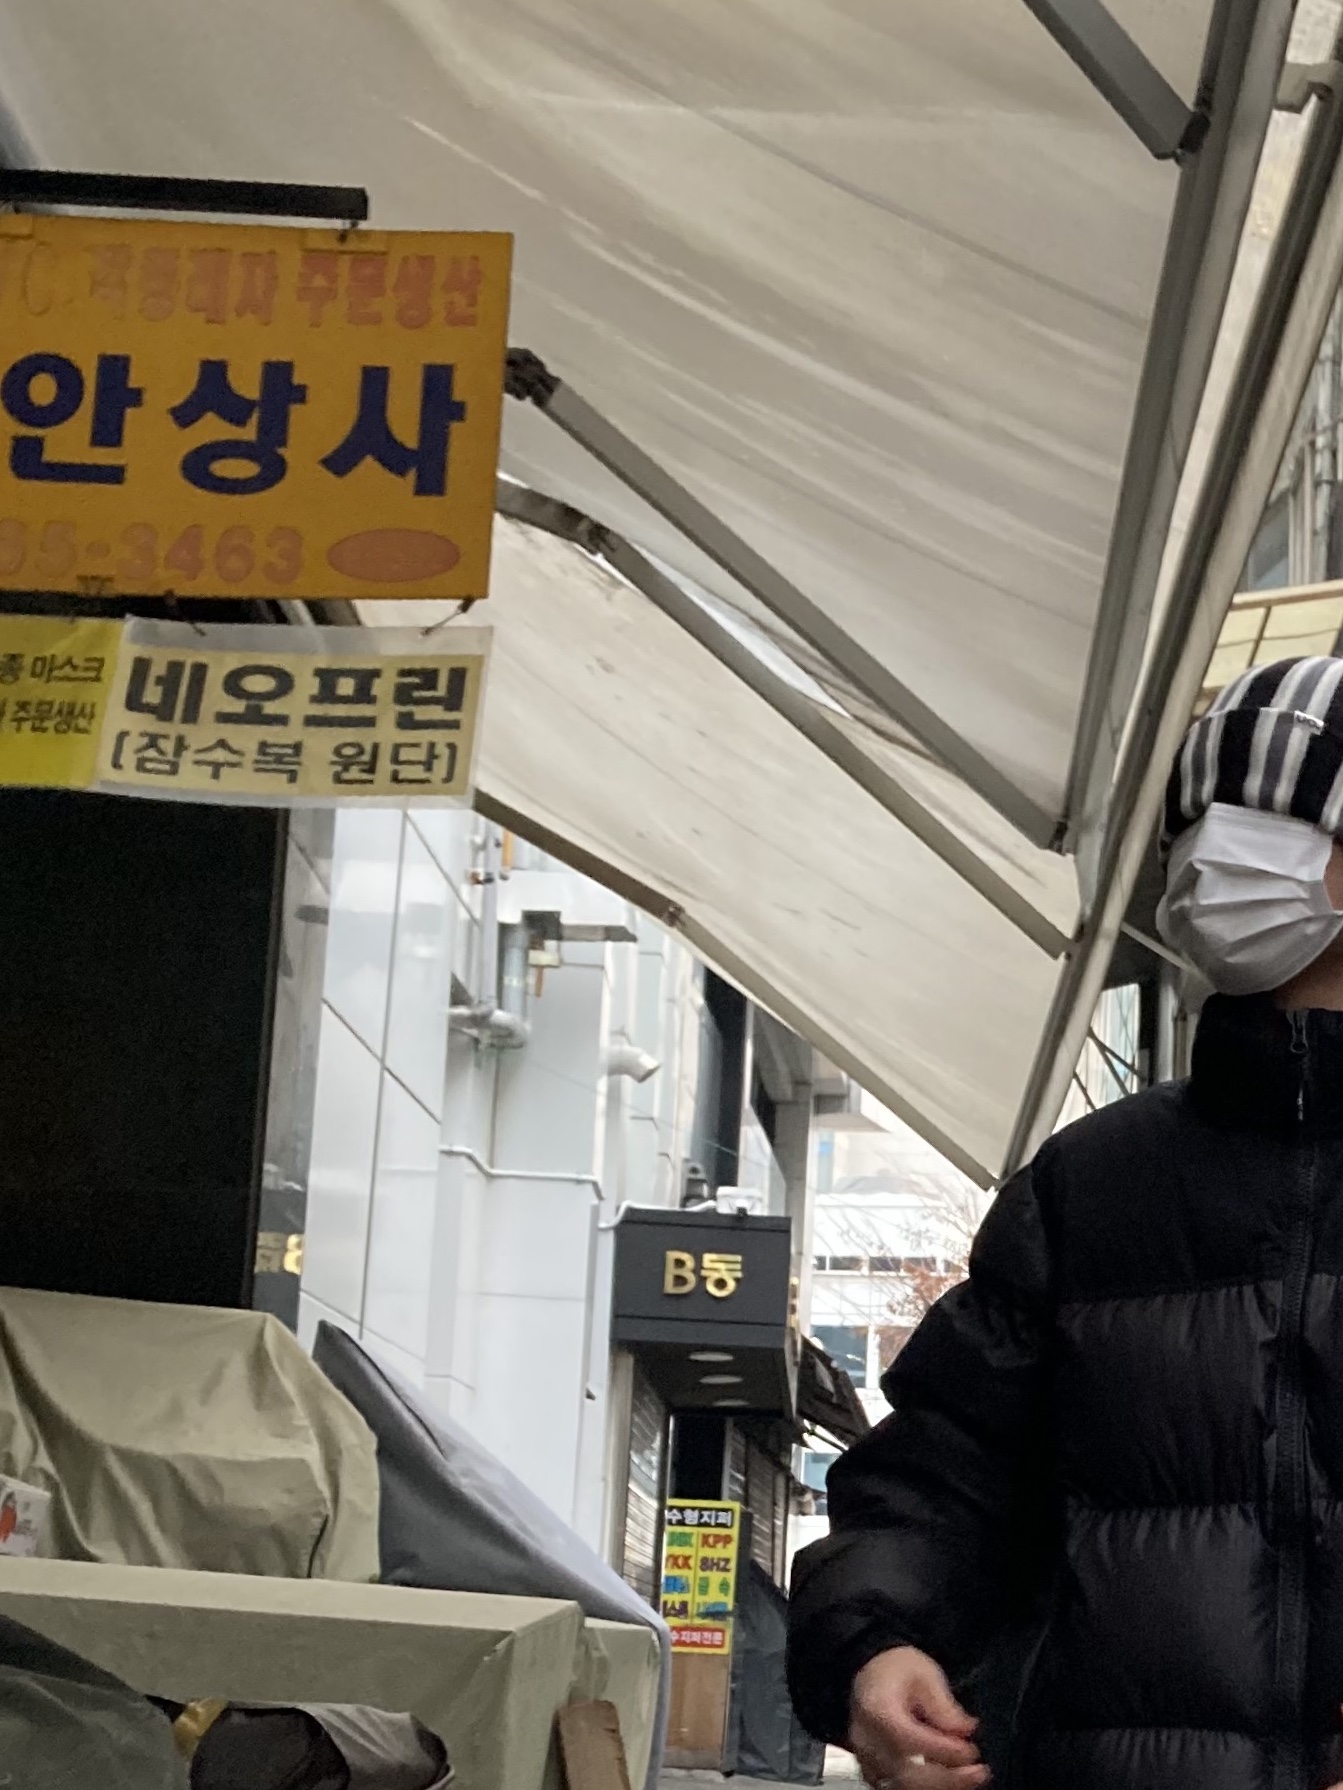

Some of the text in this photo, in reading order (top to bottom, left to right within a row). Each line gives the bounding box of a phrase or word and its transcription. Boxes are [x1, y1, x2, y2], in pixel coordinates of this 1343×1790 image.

[30, 654, 106, 684] 마스크
[124, 656, 469, 731] 네오프린
[662, 1250, 743, 1298] B동
